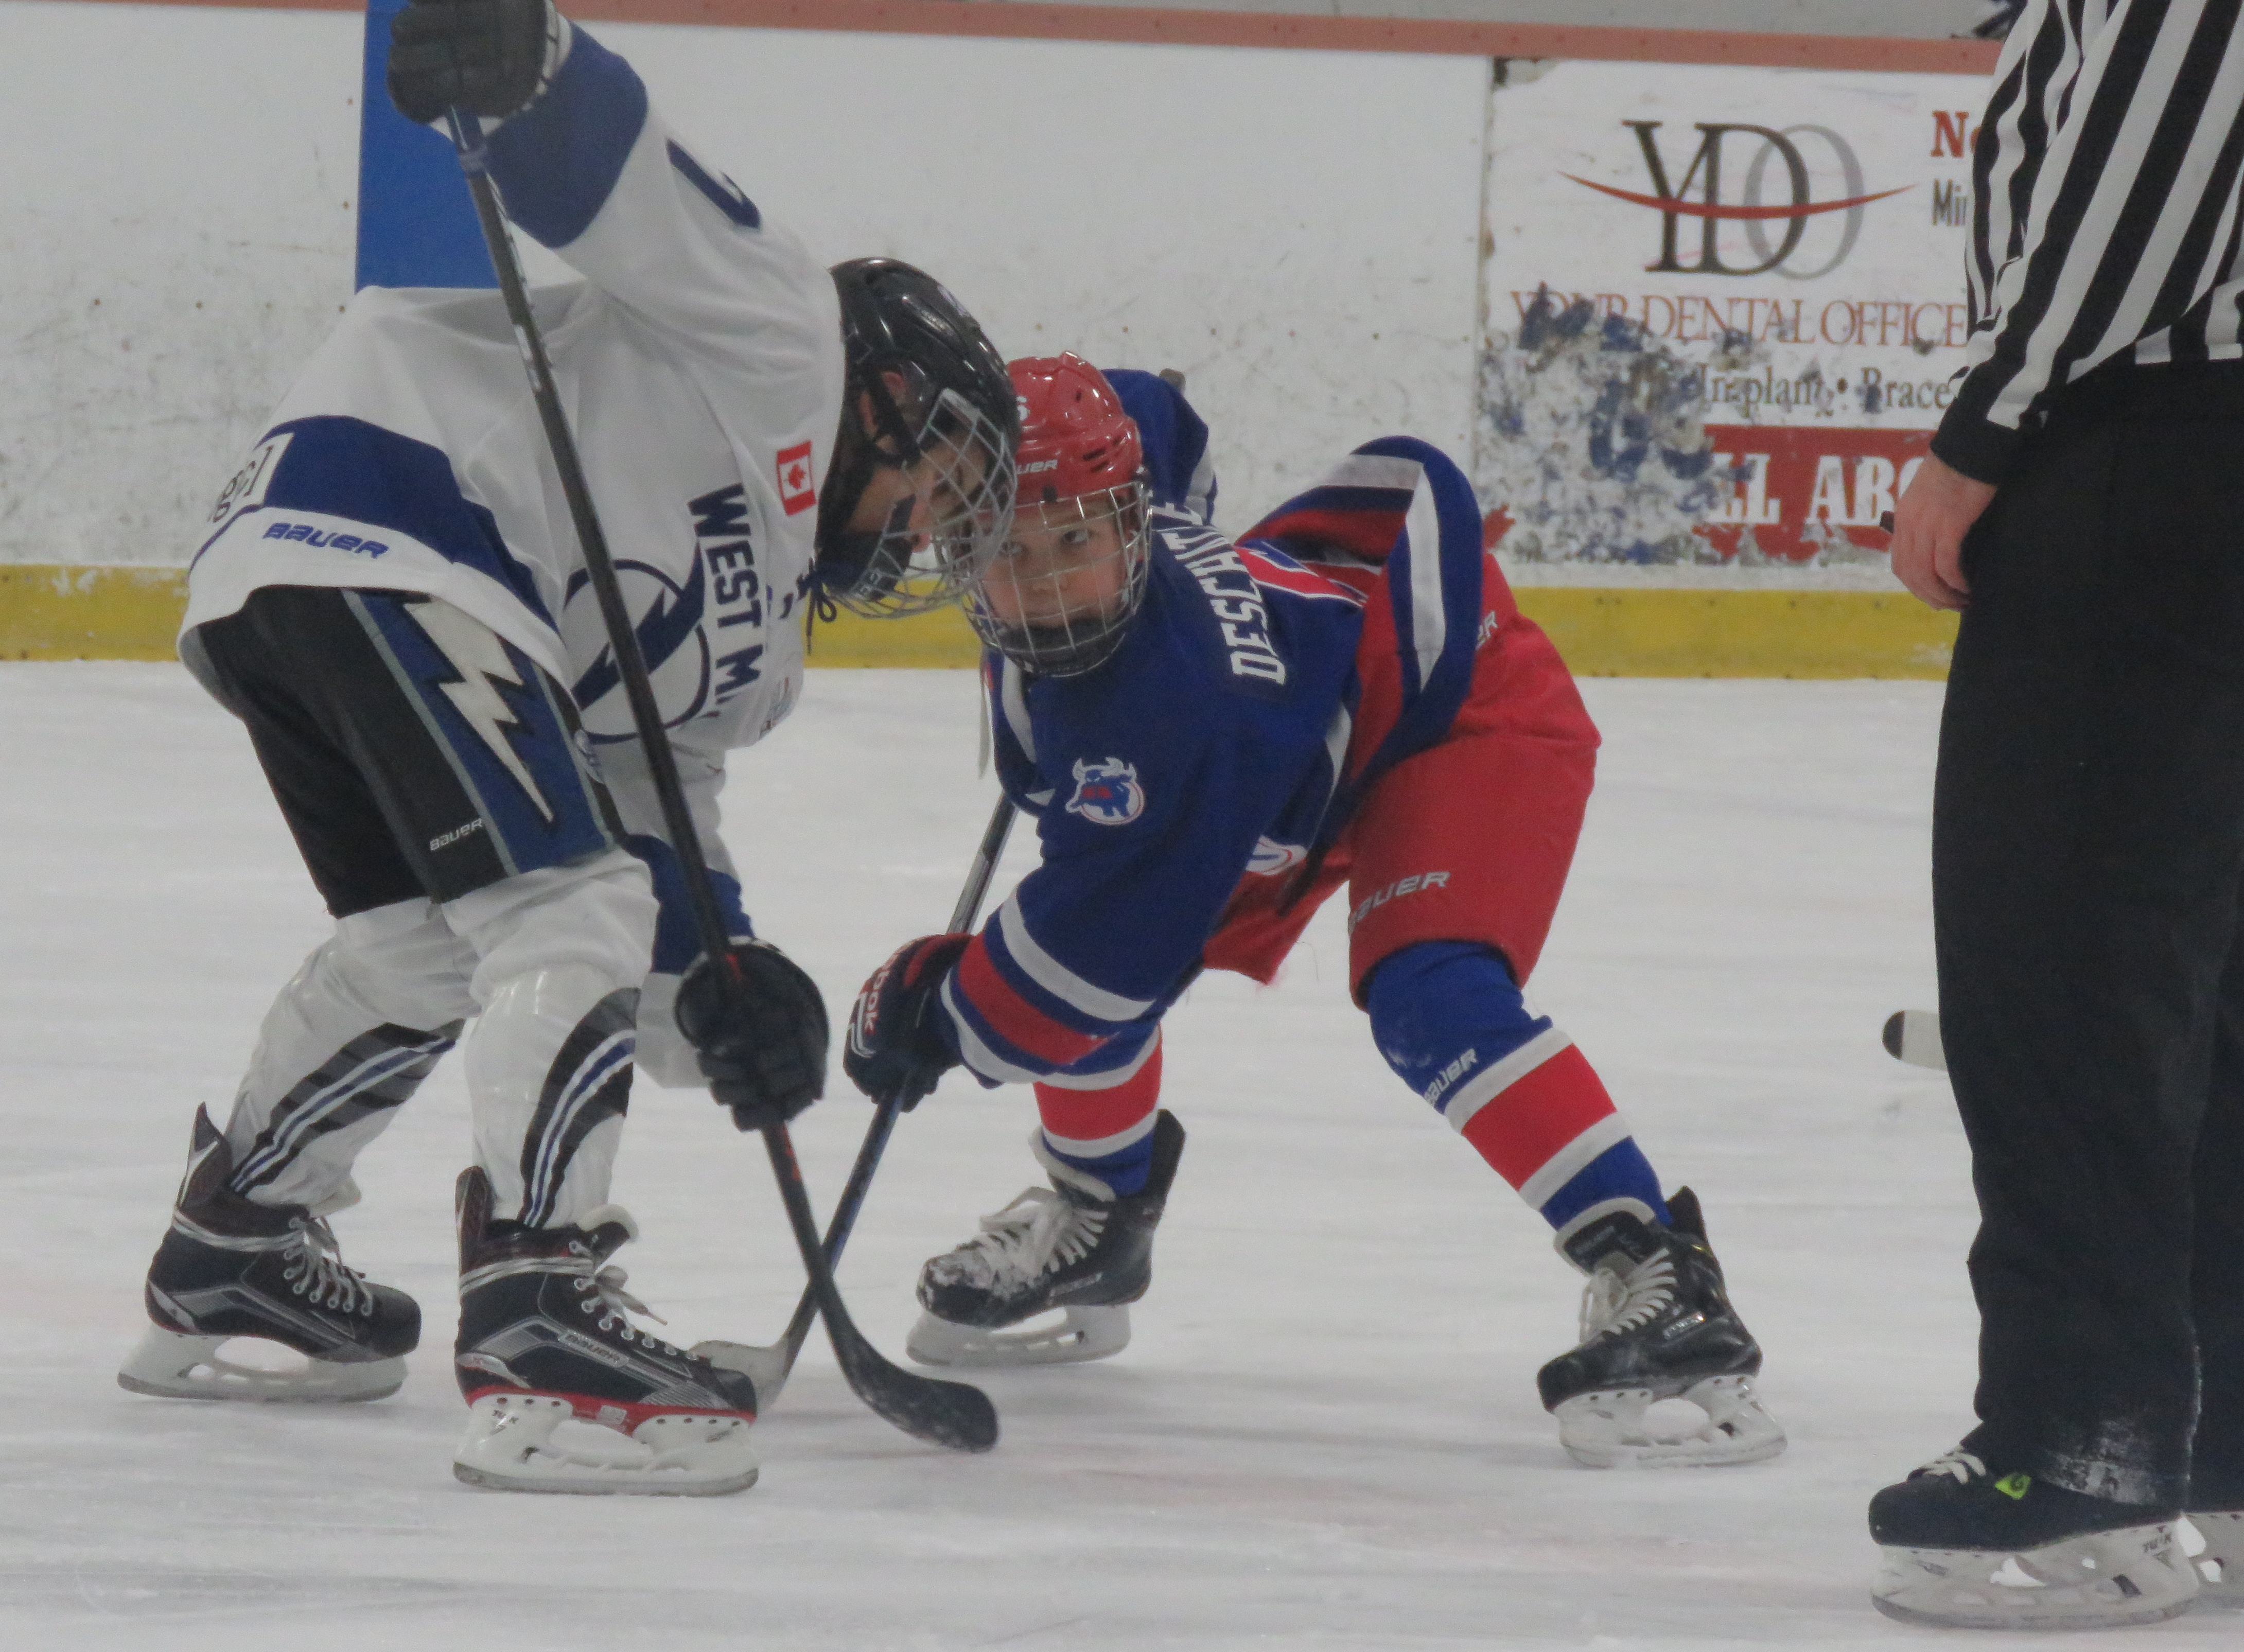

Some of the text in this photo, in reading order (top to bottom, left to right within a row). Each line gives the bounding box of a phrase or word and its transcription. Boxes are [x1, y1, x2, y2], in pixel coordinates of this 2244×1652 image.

[1641, 294, 1816, 344] DENTAL
[1820, 300, 1968, 348] OFFICE
[262, 522, 390, 559] BAUER
[688, 482, 763, 629] WEST
[429, 818, 483, 852] BAUER
